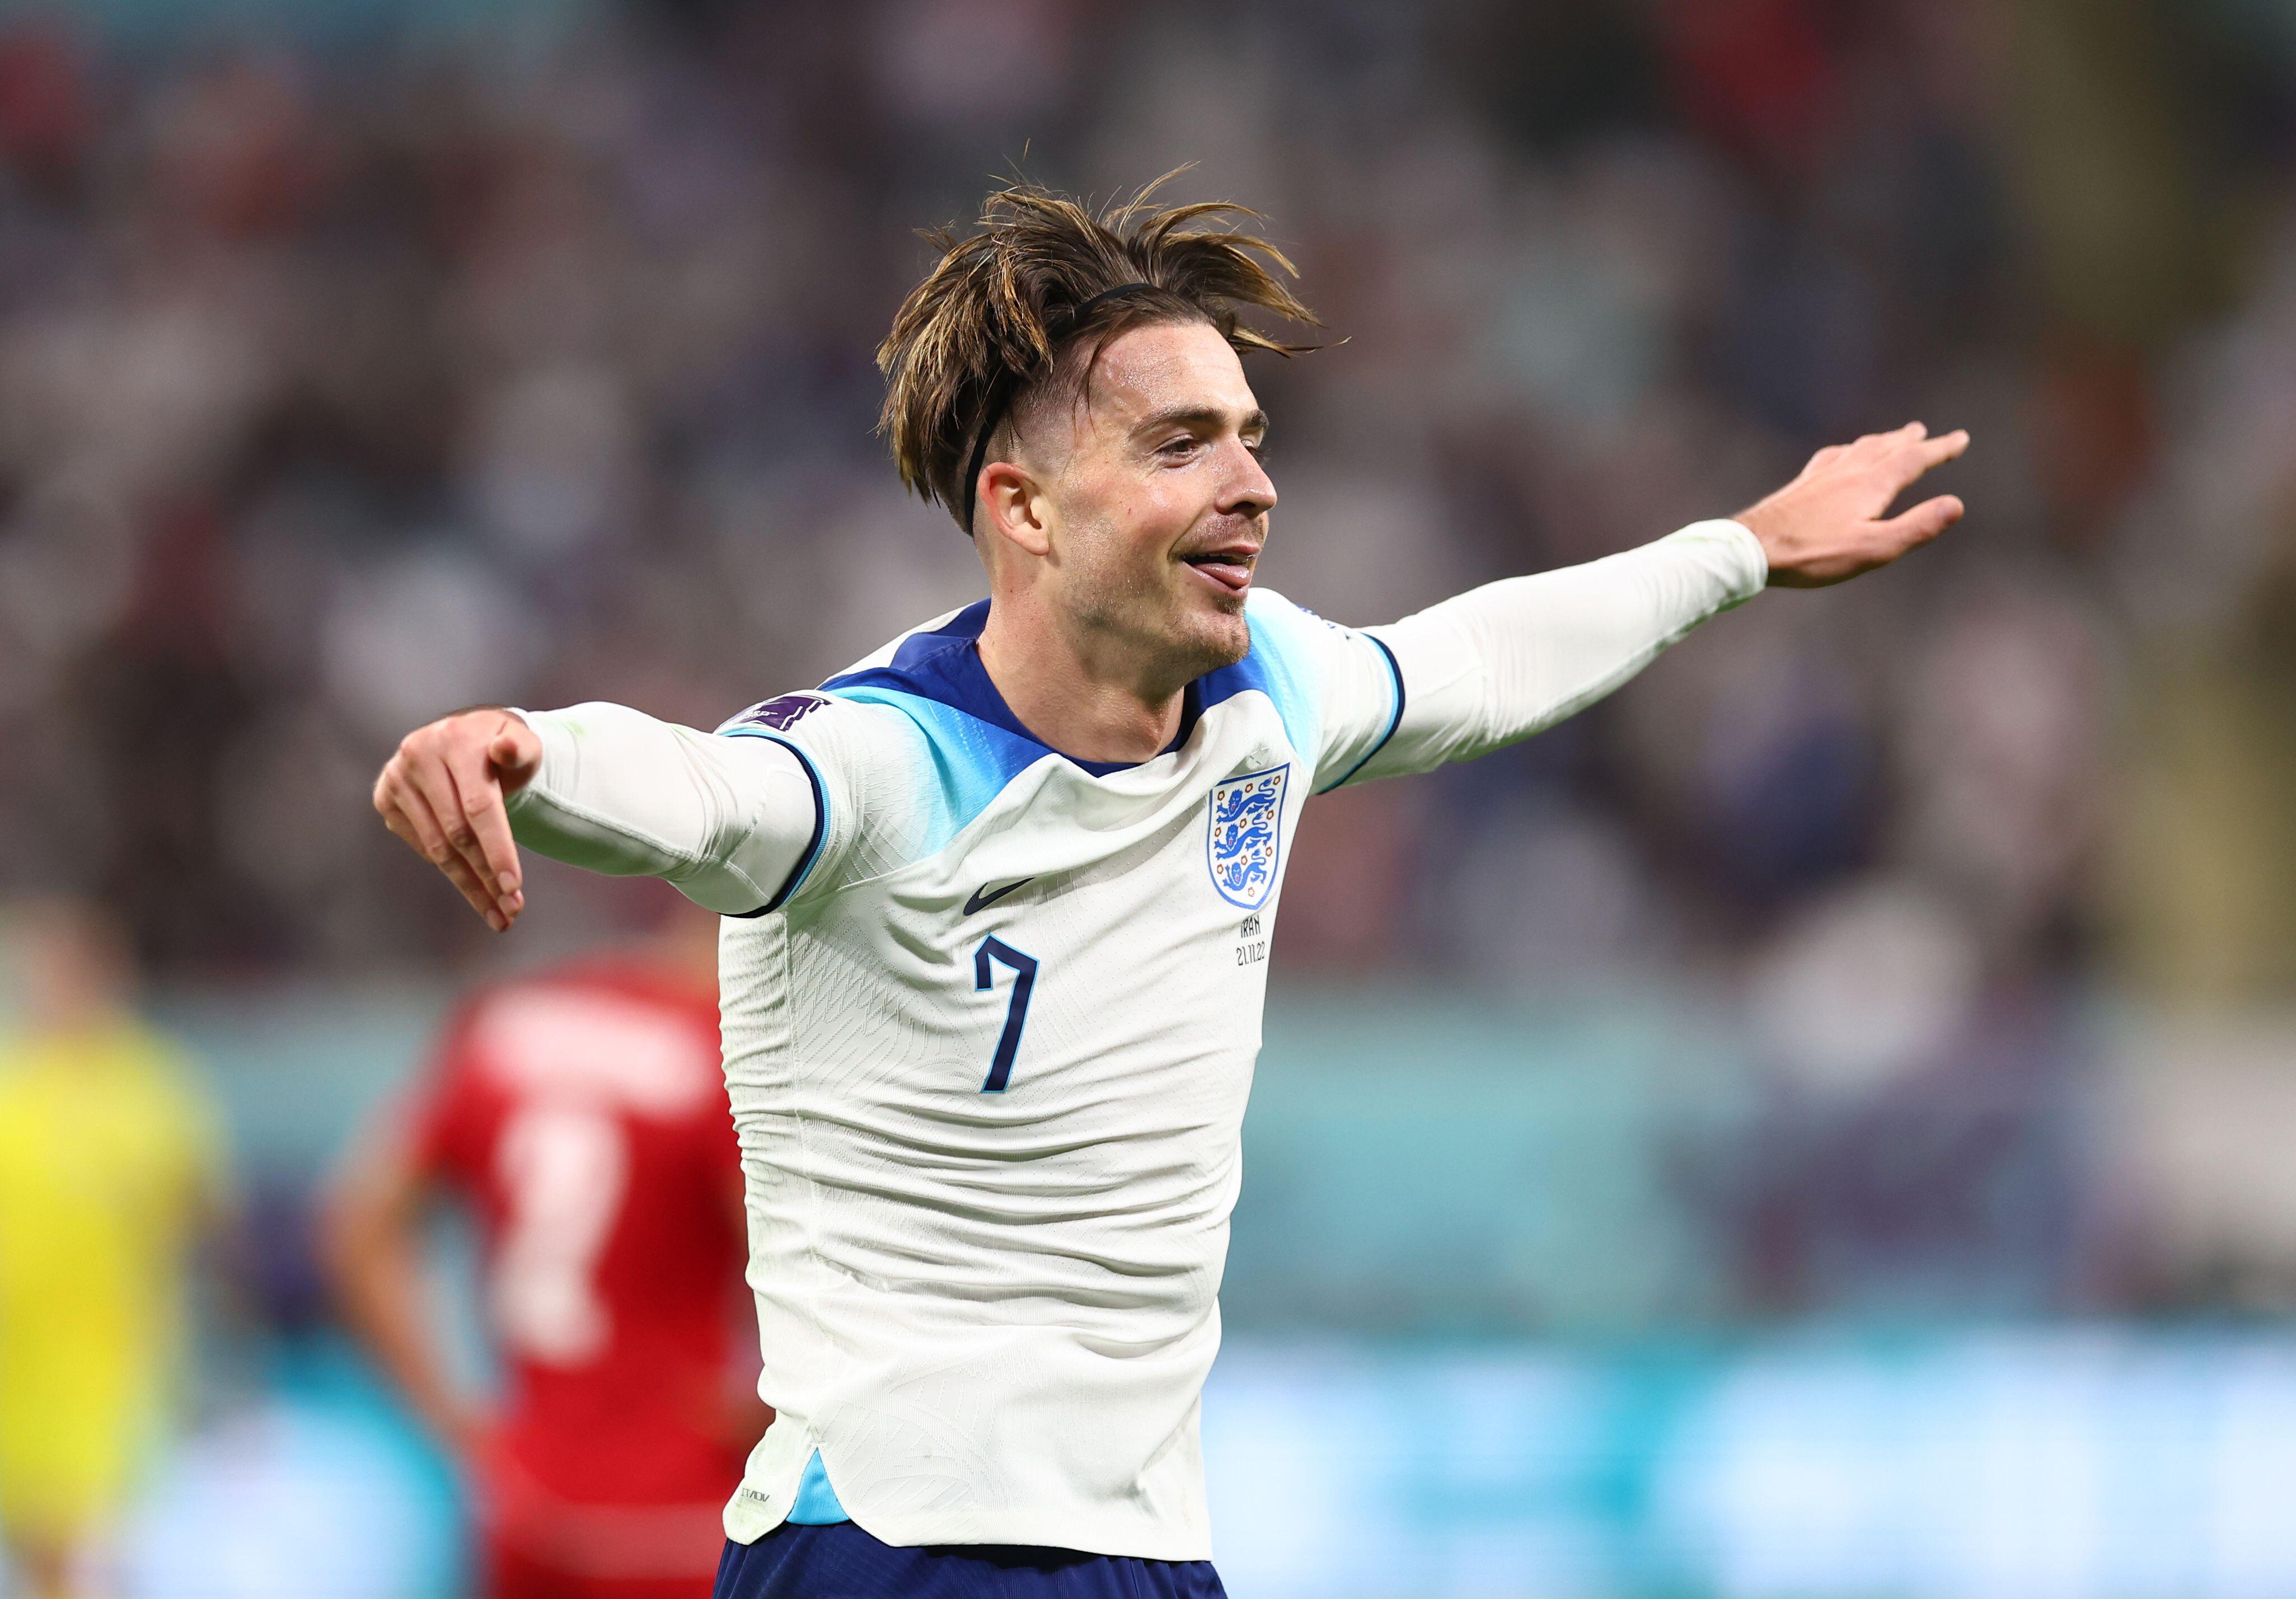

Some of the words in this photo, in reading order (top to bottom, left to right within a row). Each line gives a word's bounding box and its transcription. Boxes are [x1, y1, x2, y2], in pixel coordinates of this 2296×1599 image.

[1241, 913, 1261, 938] IRAN
[1236, 941, 1265, 965] 21.11.22
[974, 933, 1040, 1093] 7
